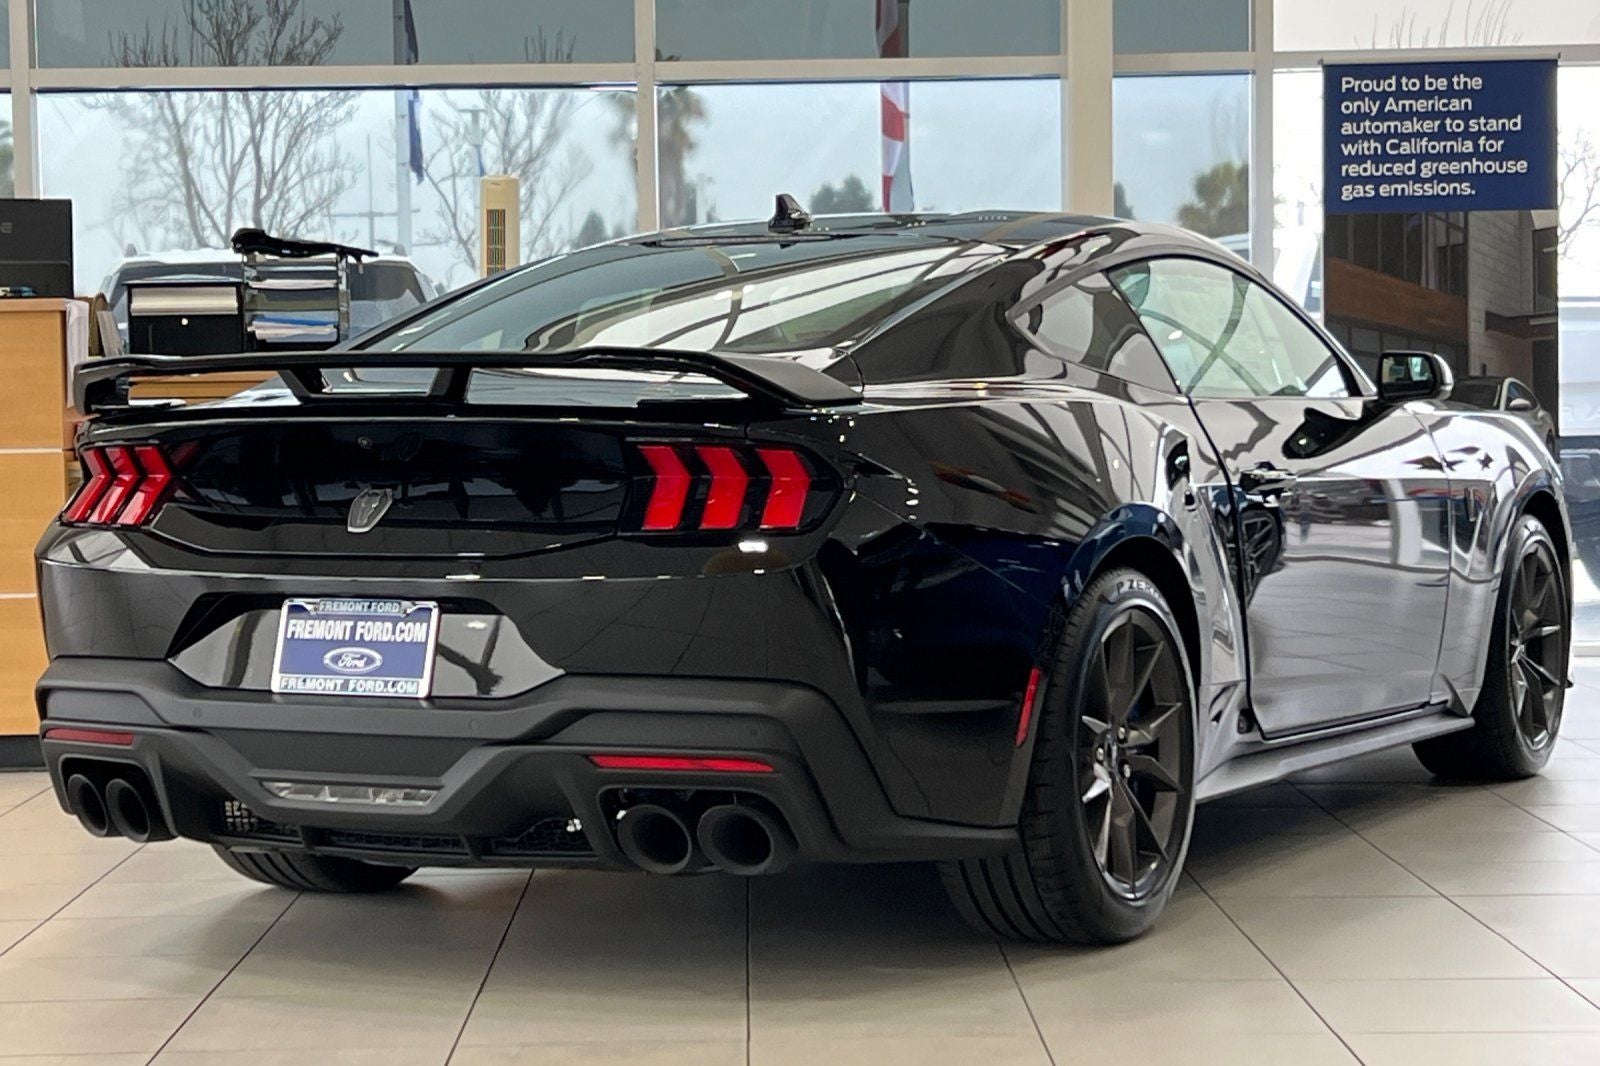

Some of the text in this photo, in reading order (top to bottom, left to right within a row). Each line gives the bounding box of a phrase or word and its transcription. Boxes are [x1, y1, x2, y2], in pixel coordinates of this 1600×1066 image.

[1341, 73, 1483, 93] Proud to be the
[1341, 95, 1473, 116] only American
[1341, 115, 1522, 135] automaker to stand
[1341, 136, 1504, 156] with California for
[1341, 157, 1528, 178] reduced greenhouse
[1341, 180, 1476, 201] gas emissions.
[319, 600, 400, 613] FREMONT FORD
[287, 619, 428, 643] FREMONT FORD.COM
[338, 652, 368, 668] Ford
[280, 677, 418, 694] FREMONT FORD.COM
